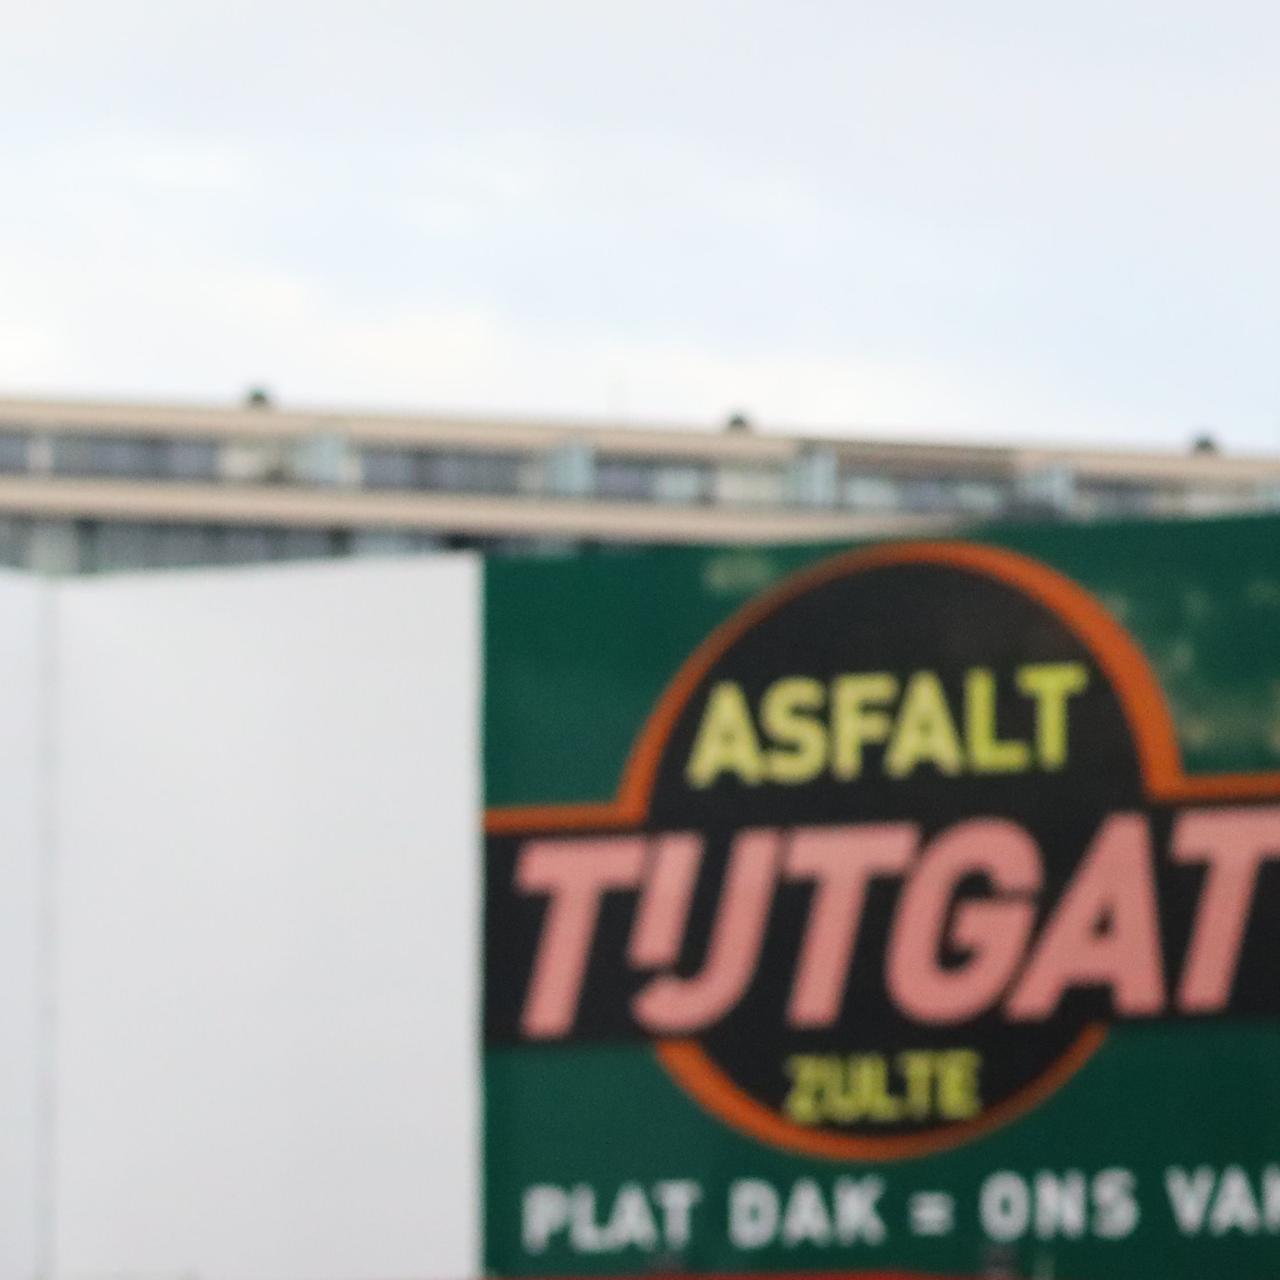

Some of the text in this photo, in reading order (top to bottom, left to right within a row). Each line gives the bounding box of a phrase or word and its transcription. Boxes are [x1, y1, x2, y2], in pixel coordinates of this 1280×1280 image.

[687, 663, 1088, 788] ASFALT
[783, 1050, 982, 1125] ZULTE
[521, 1179, 700, 1256] PLAT
[729, 1177, 886, 1248] DAK
[980, 1166, 1138, 1243] ONS
